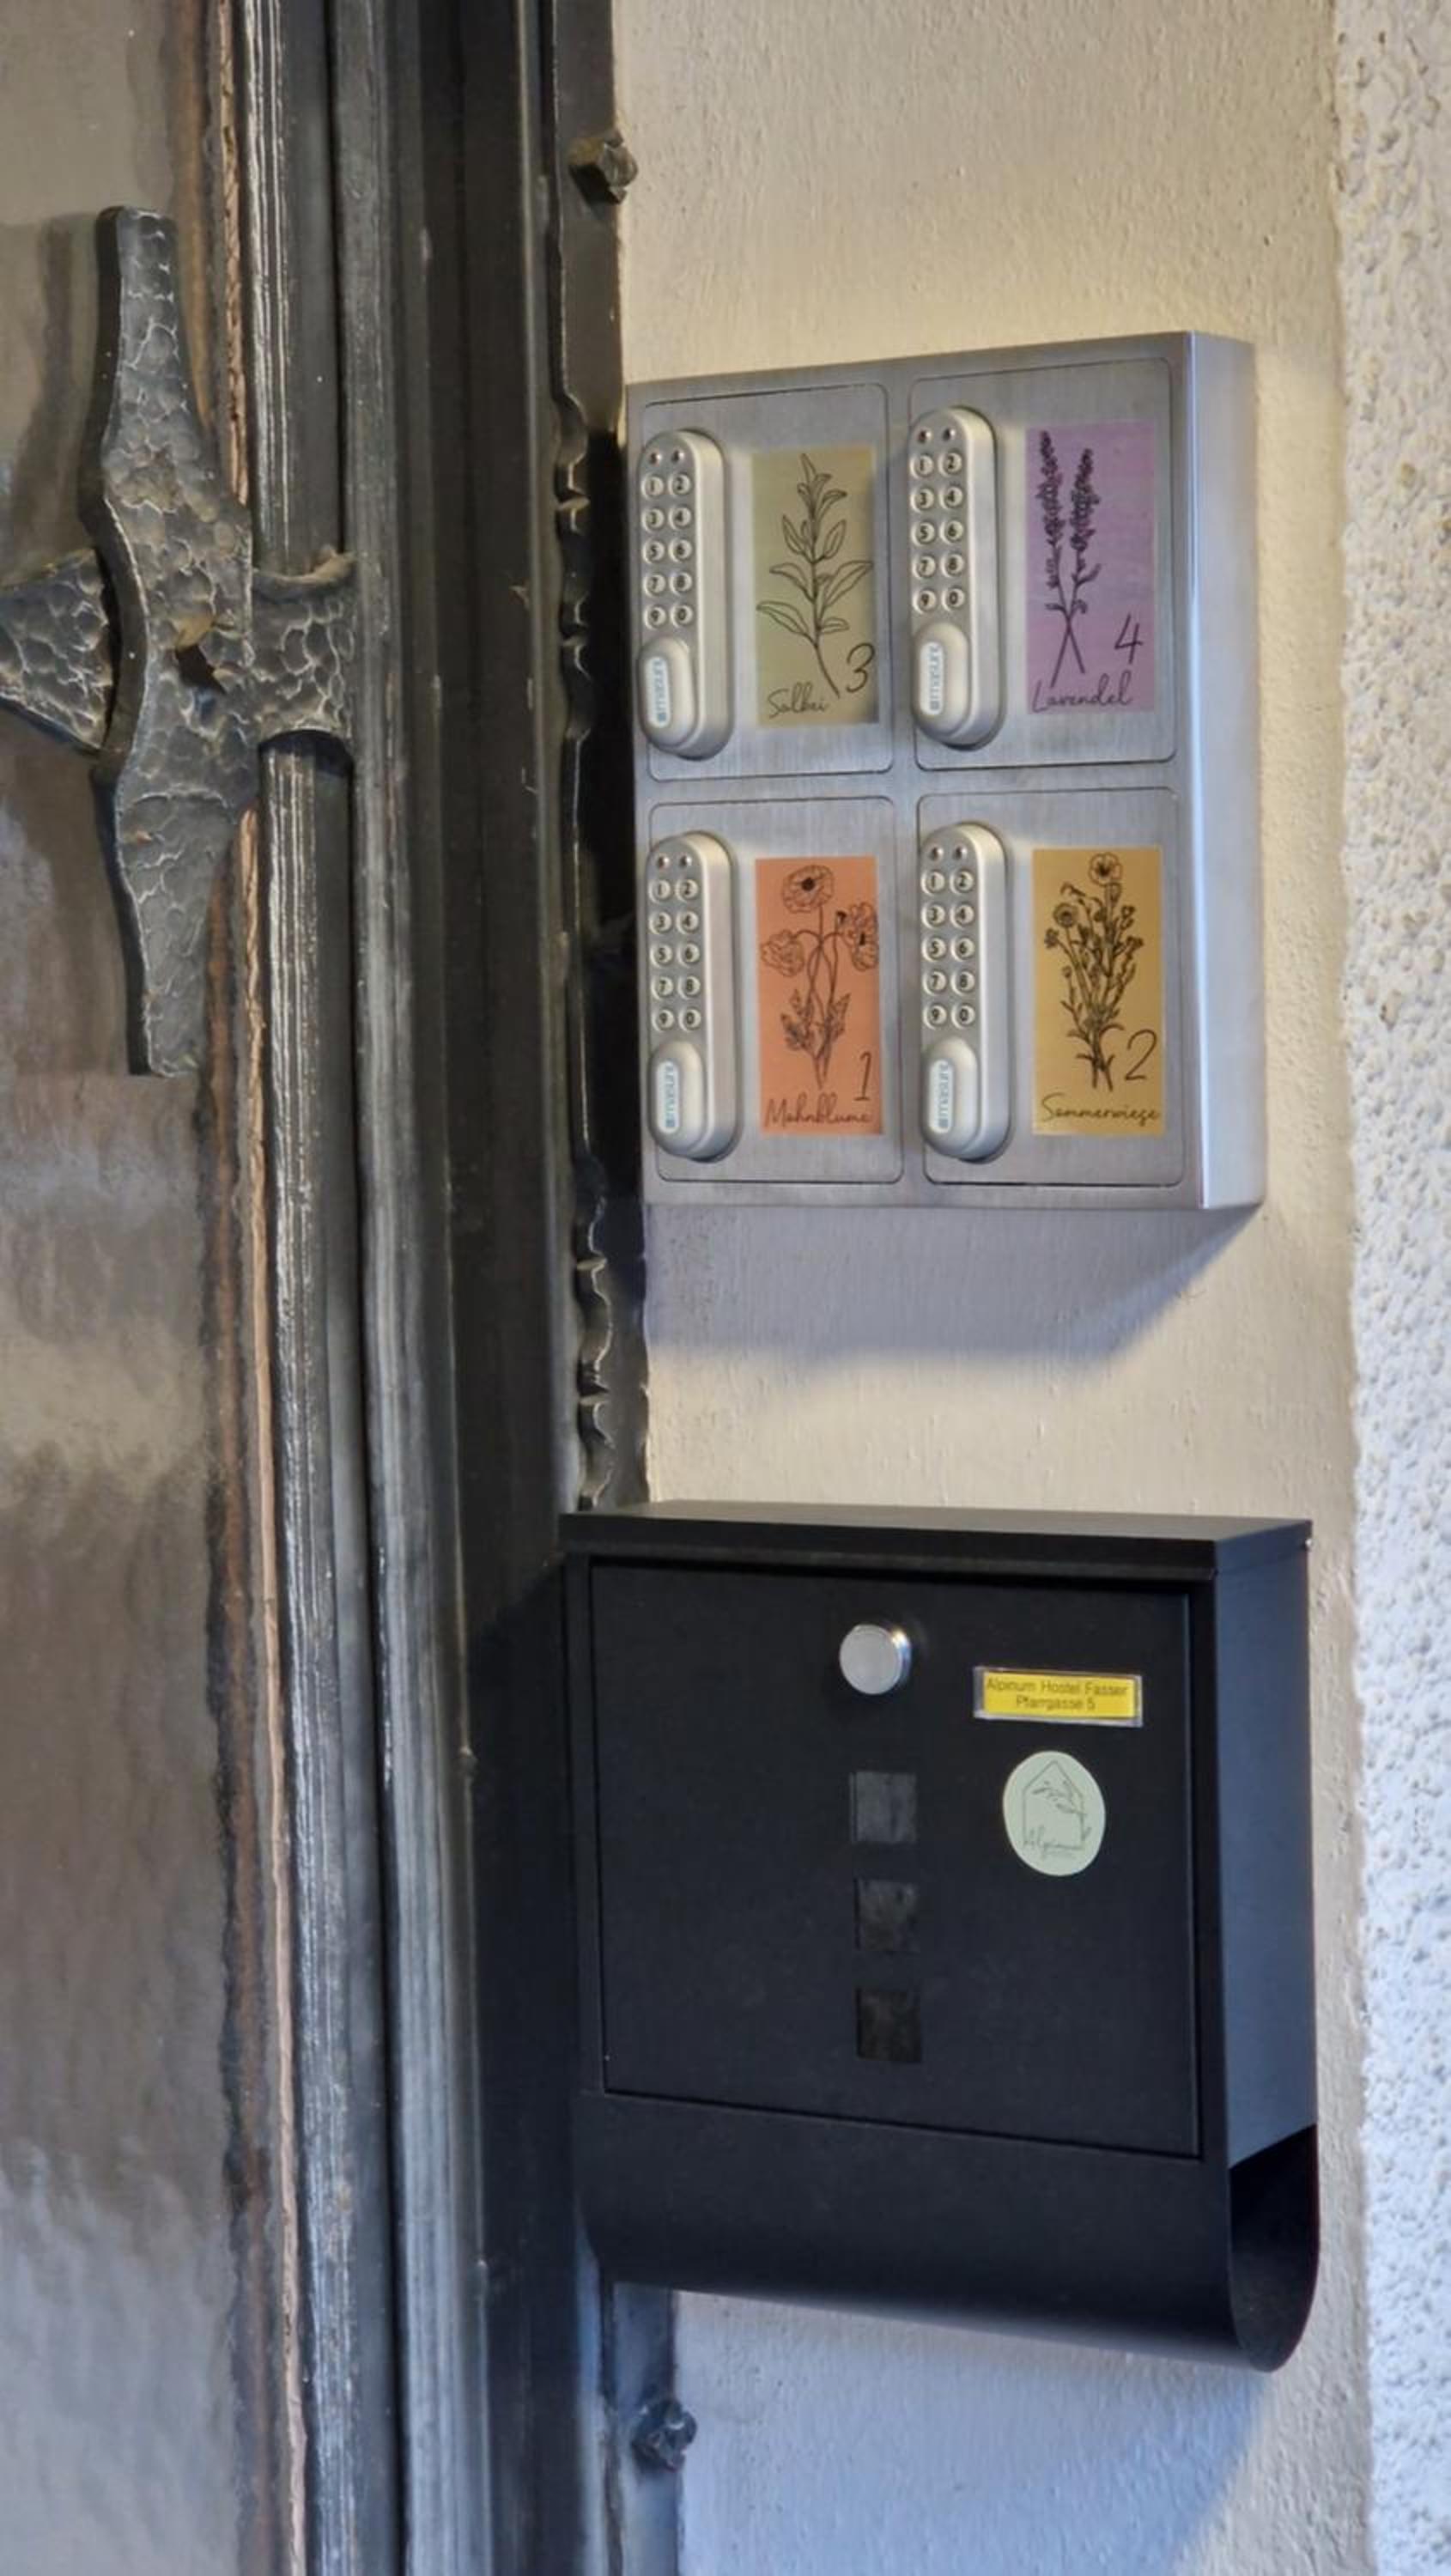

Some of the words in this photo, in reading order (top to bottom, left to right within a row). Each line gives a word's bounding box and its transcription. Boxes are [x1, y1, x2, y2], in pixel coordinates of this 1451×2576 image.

[1114, 613, 1144, 665] 4
[846, 642, 875, 693] 3
[1032, 670, 1133, 713] Lavendel
[853, 1050, 871, 1102] 1
[1124, 1029, 1157, 1080] 2
[987, 1677, 1036, 1693] Alpinum
[1041, 1680, 1080, 1695] Hostel
[1087, 1697, 1096, 1711] 5
